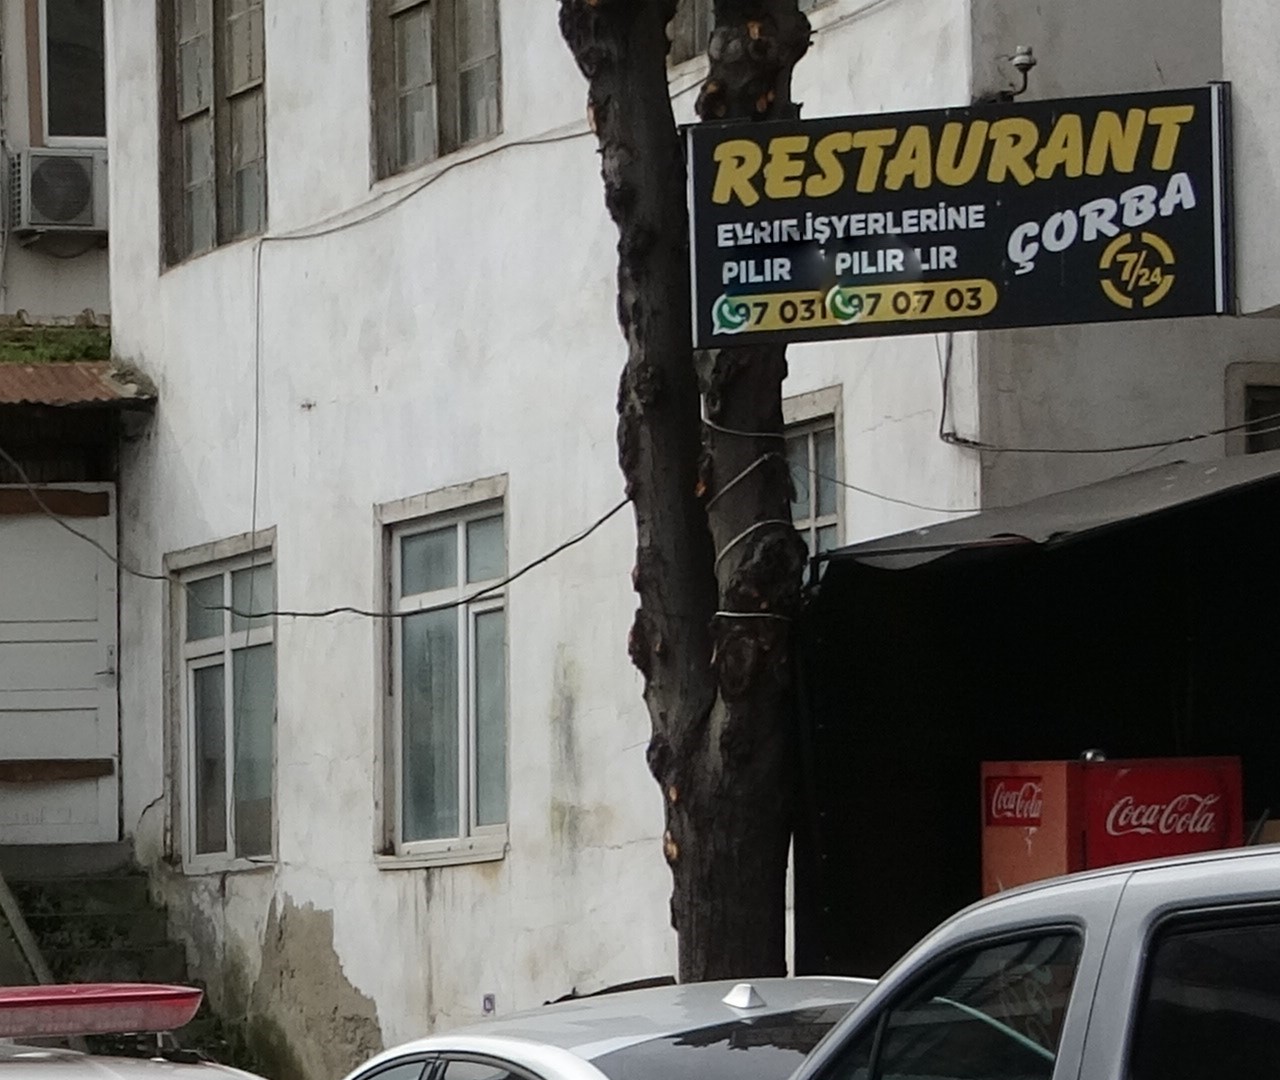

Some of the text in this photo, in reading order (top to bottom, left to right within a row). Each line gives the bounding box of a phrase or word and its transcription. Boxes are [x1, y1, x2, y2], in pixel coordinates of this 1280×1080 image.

[712, 105, 1195, 207] RESTAURANT
[805, 202, 987, 244] İŞYERLERİNE
[1007, 172, 1196, 276] ÇORBA
[722, 257, 792, 285] PILIR
[835, 248, 905, 276] PILIR
[1115, 250, 1163, 292] 7/24
[945, 287, 983, 311] 03
[991, 782, 1043, 819] Coca-Cola
[1106, 794, 1221, 836] Coca-Cola
